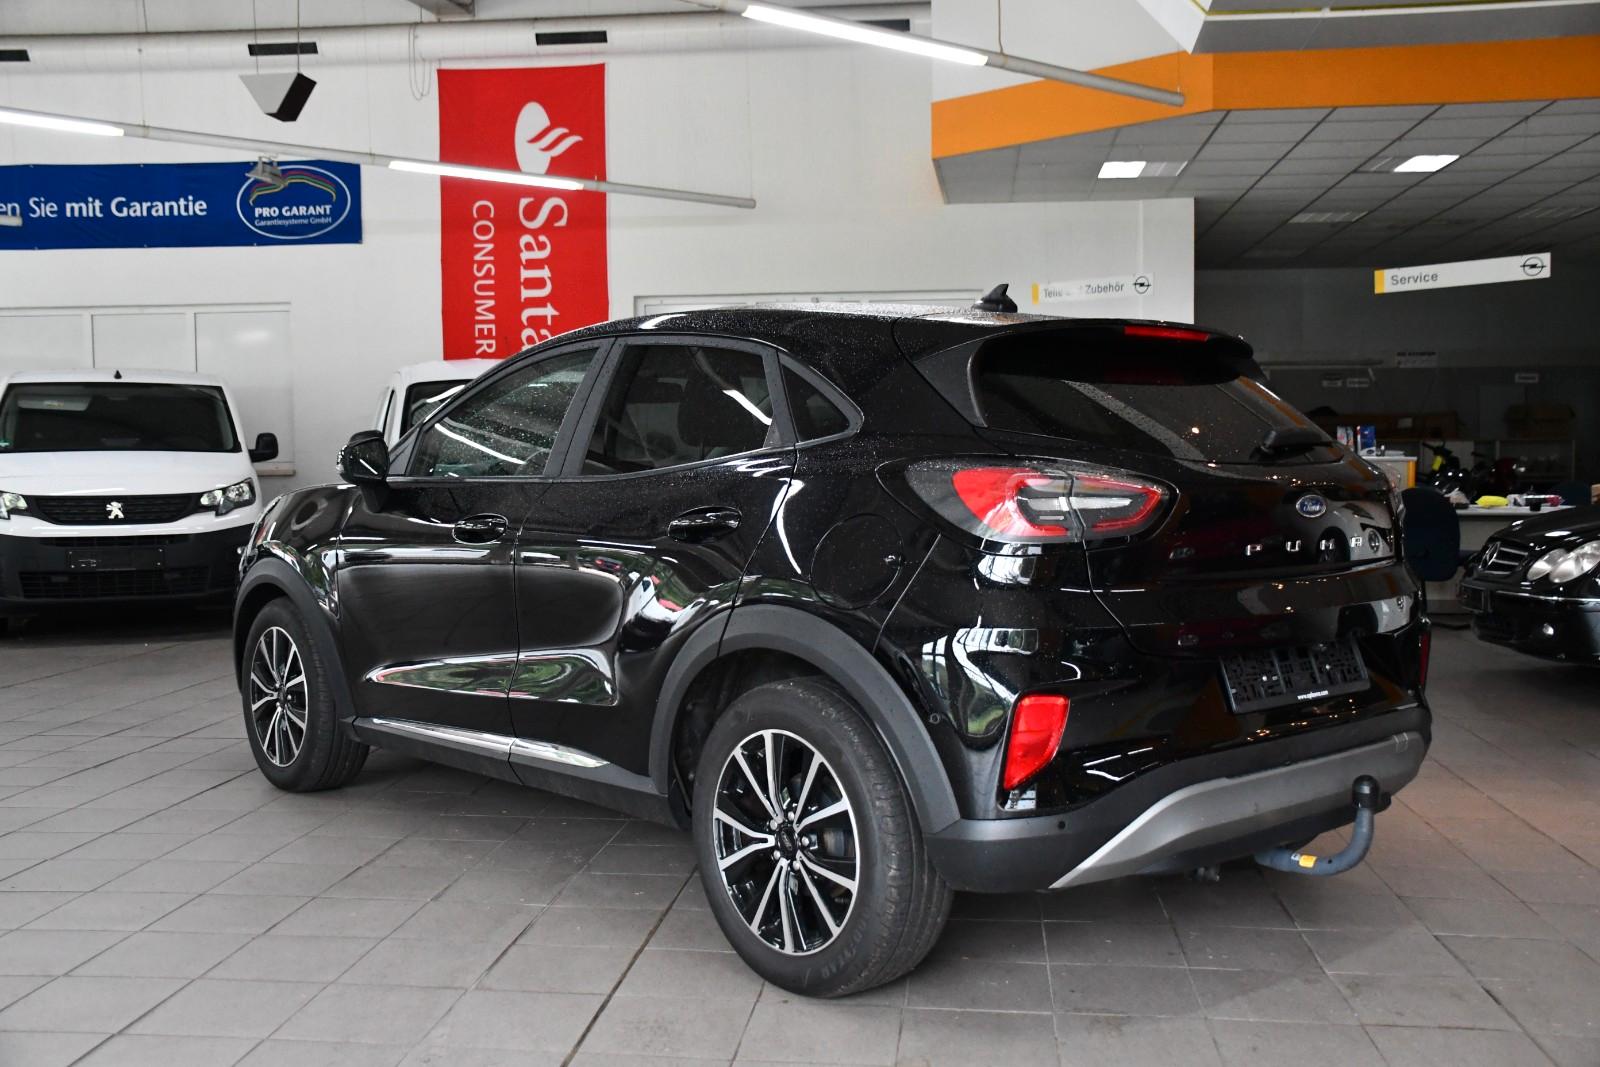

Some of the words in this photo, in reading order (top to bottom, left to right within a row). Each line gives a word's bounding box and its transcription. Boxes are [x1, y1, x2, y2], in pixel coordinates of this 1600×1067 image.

[28, 196, 58, 218] Sie
[65, 196, 103, 218] mit
[110, 195, 208, 217] Garantie
[254, 206, 279, 218] PRO
[281, 204, 333, 217] GARANT
[310, 215, 333, 225] GmbH
[472, 200, 497, 355] CONSUMER
[1390, 272, 1439, 286] Service
[1084, 281, 1125, 295] Zubehör
[1245, 536, 1363, 556] PUMA
